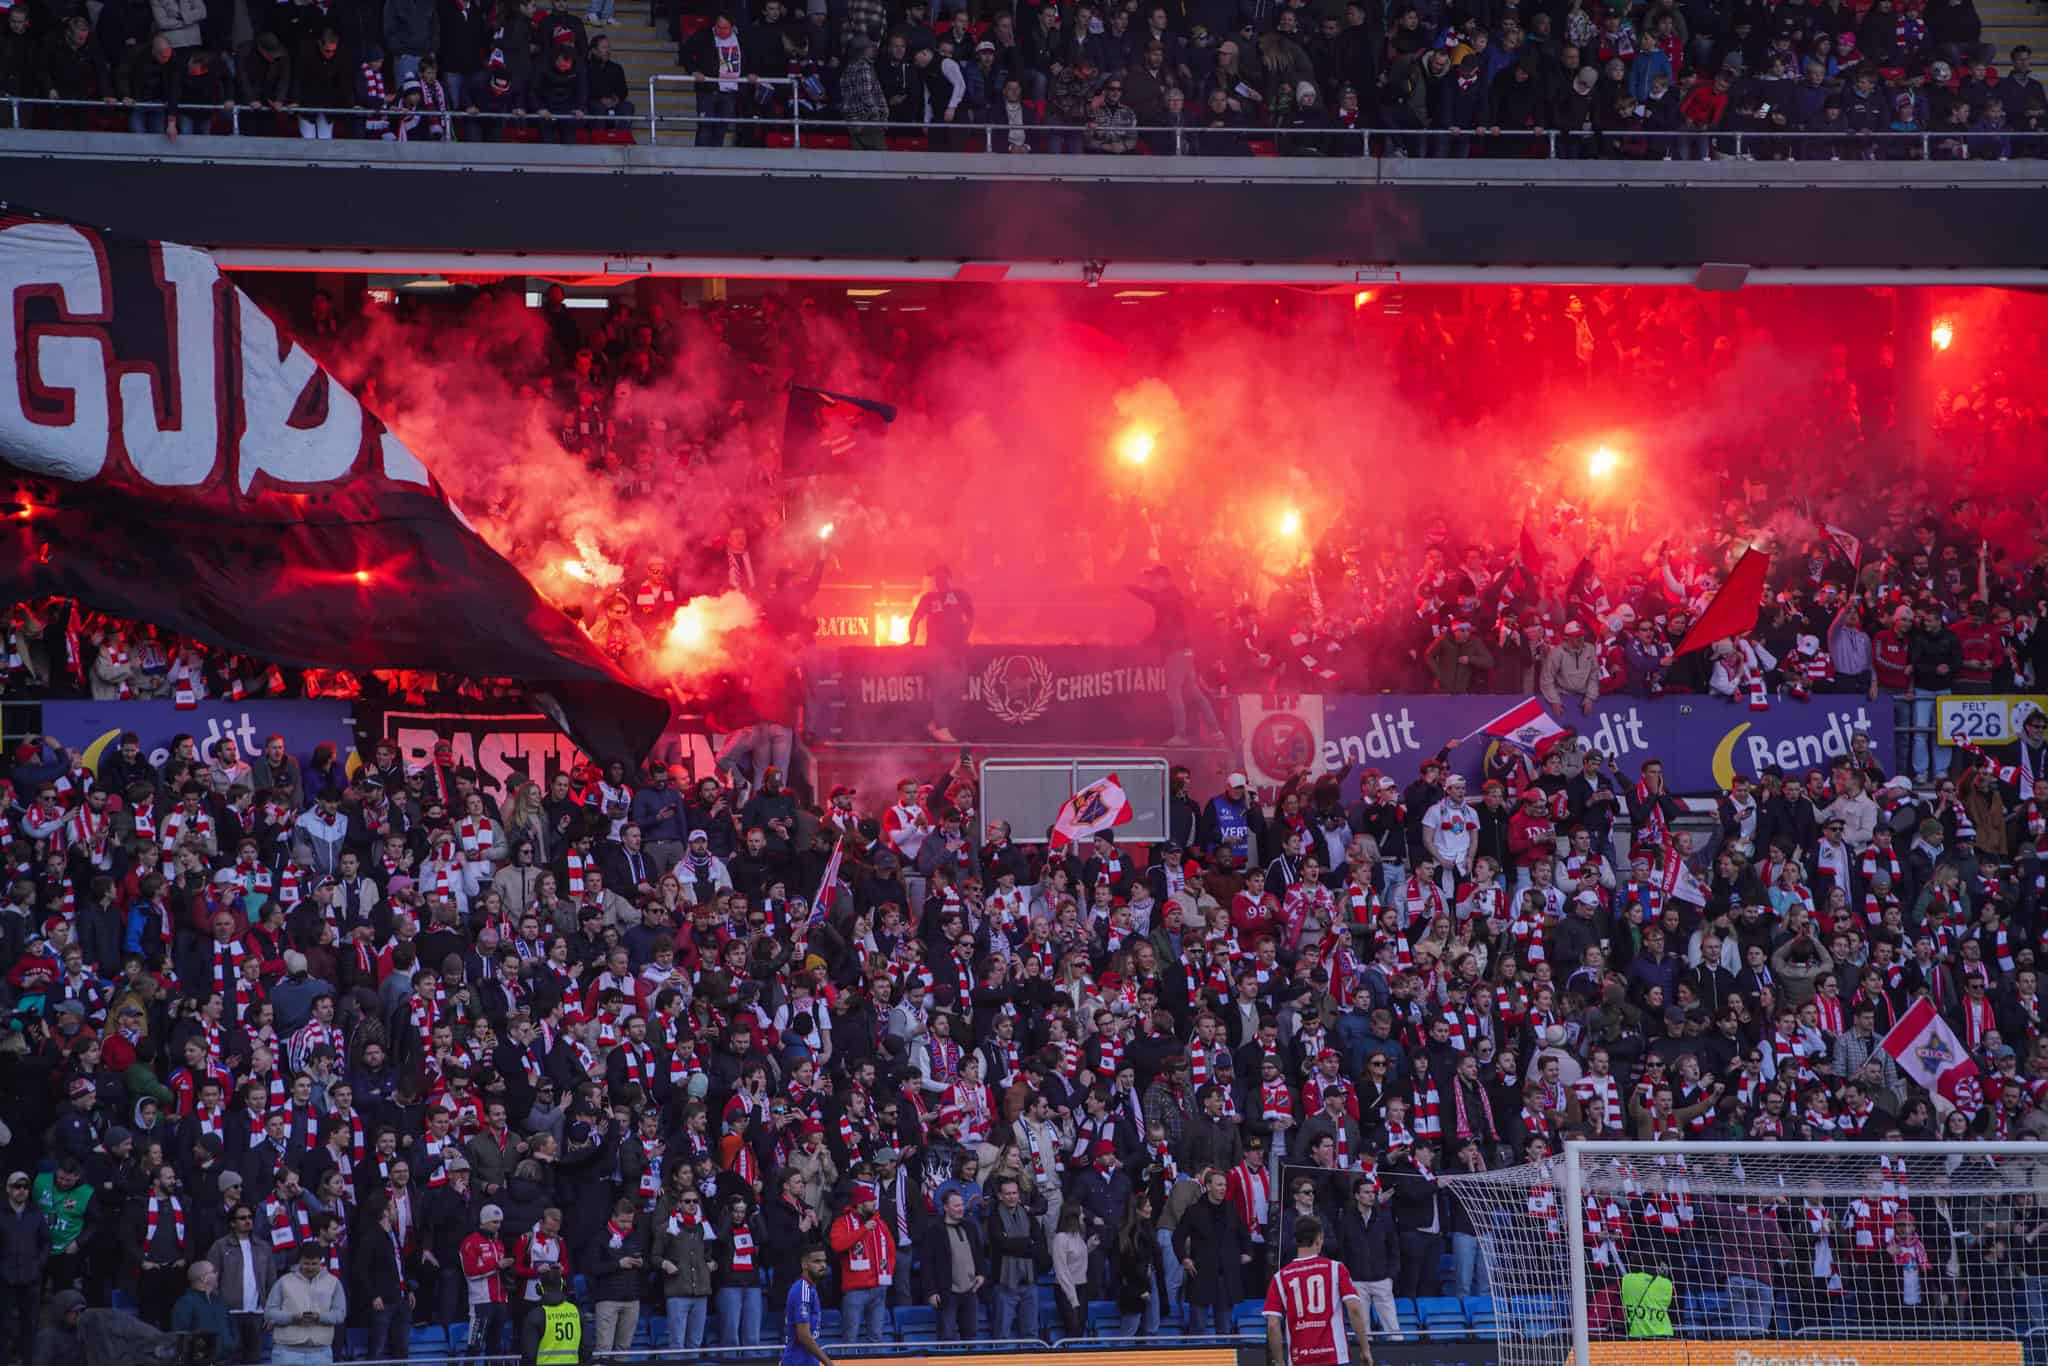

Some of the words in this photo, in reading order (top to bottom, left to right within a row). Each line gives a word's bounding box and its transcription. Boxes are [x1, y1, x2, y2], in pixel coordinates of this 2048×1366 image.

[1962, 702, 1987, 712] FELT
[1950, 713, 2001, 737] 226
[1288, 1273, 1326, 1319] 10
[555, 1321, 574, 1341] 50
